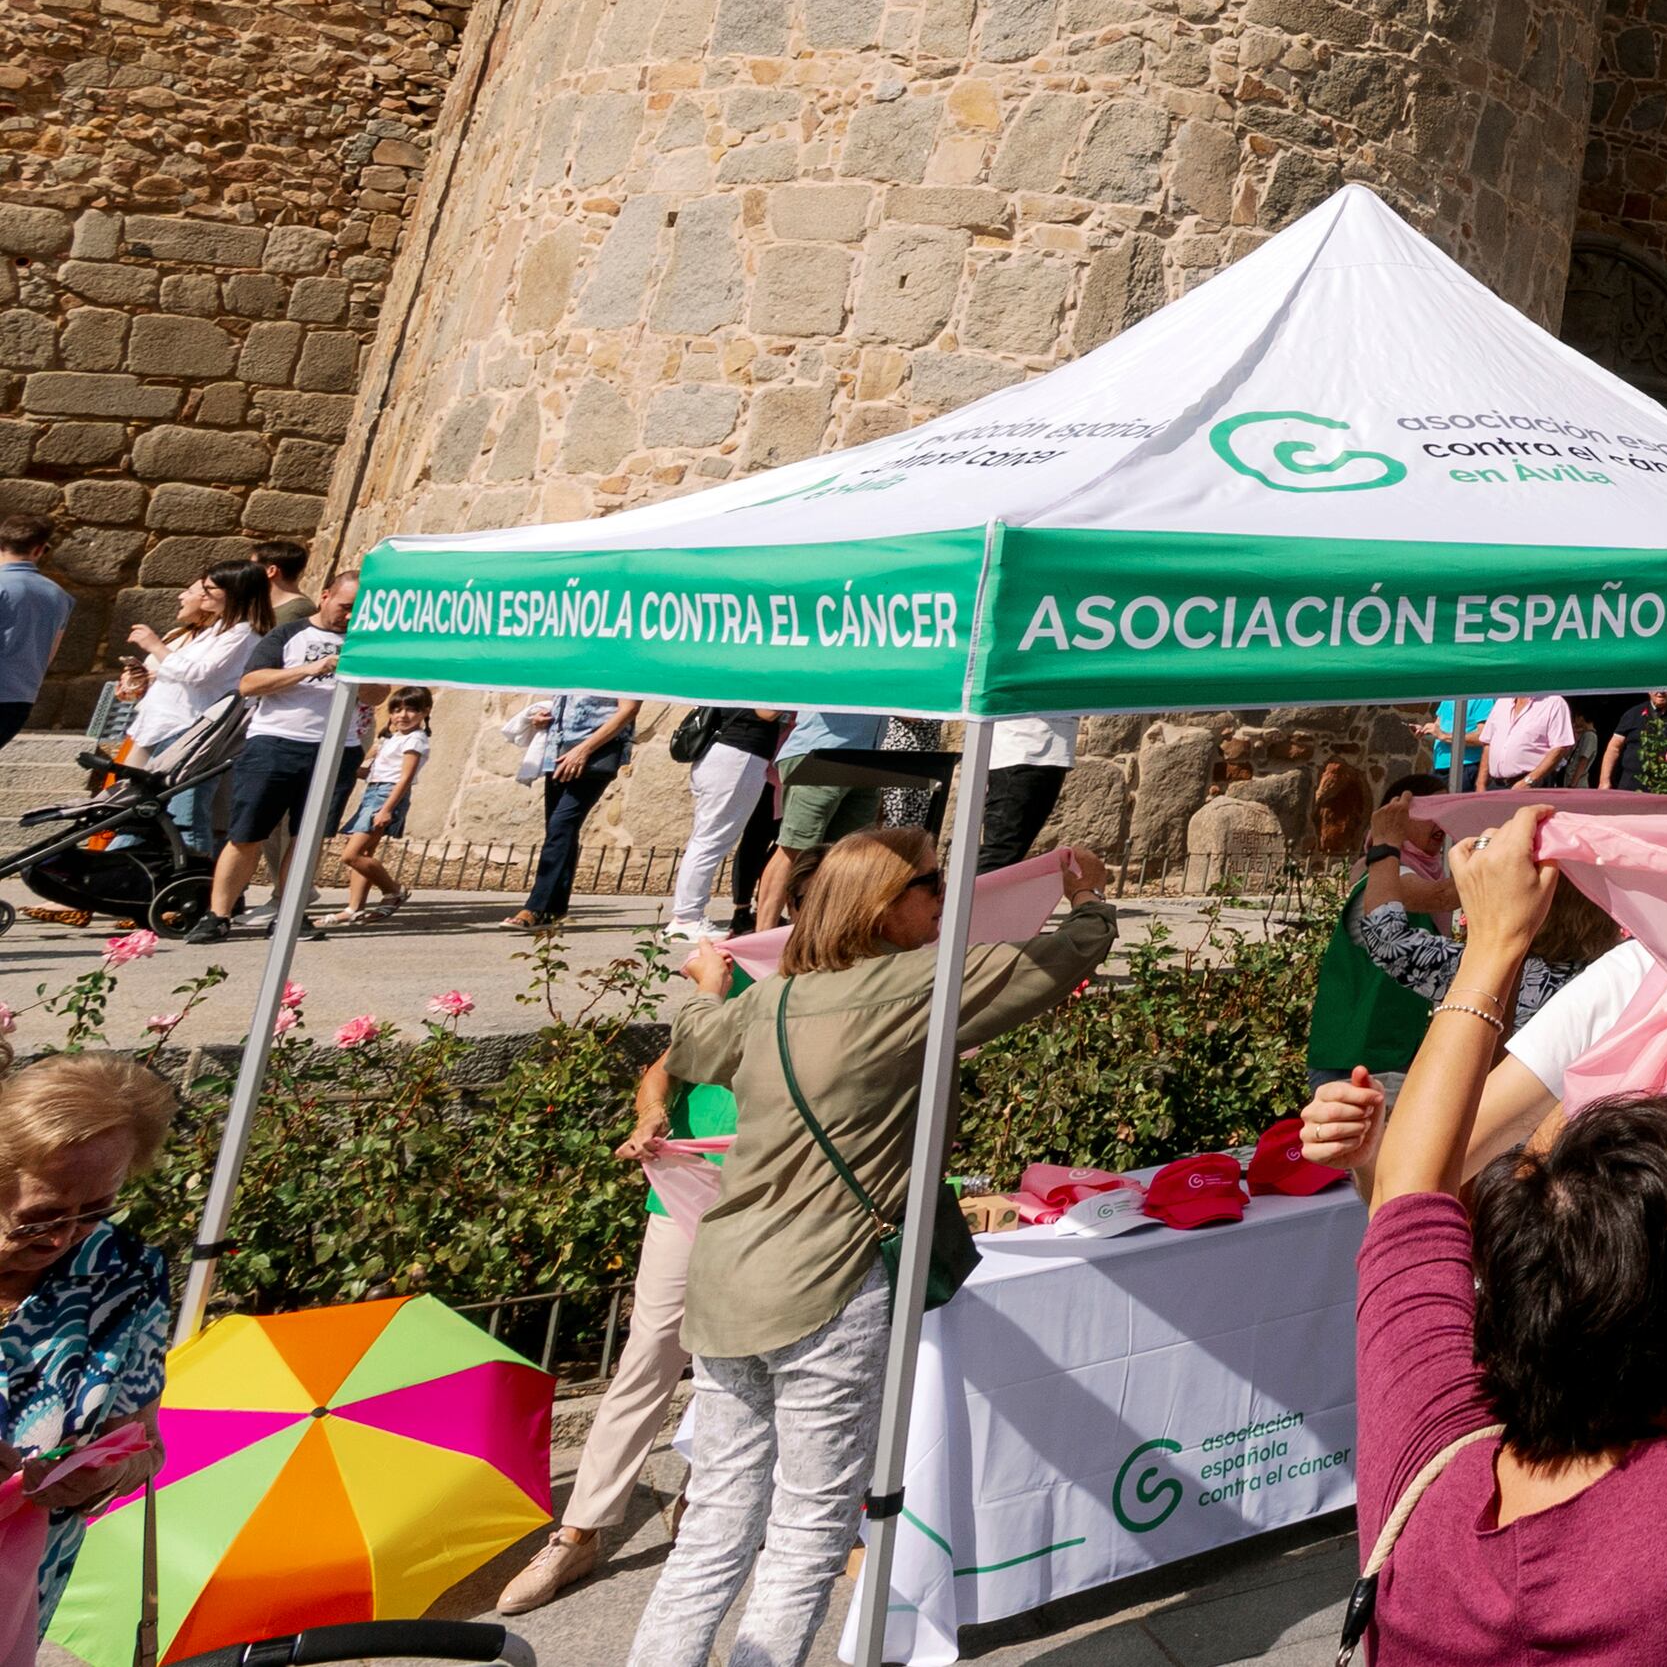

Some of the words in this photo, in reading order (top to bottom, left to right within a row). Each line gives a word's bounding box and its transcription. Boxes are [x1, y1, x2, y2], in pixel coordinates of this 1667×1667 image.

[1397, 409, 1612, 444] asociación
[1422, 437, 1562, 458] contra
[1568, 446, 1605, 463] el
[1449, 468, 1509, 483] en
[1512, 458, 1617, 486] Ávila
[351, 578, 494, 635] ASOCIACIÓN
[497, 577, 633, 639] ESPAÑOLA
[640, 591, 764, 646] CONTRA
[769, 594, 810, 646] EL
[816, 579, 958, 648] CÁNCER
[1017, 582, 1437, 652] ASOCIACIÓN
[1201, 1410, 1304, 1453] asociación
[1198, 1475, 1262, 1507] contra
[1266, 1464, 1283, 1485] el
[1287, 1447, 1353, 1479] cáncer
[1201, 1440, 1289, 1480] española
